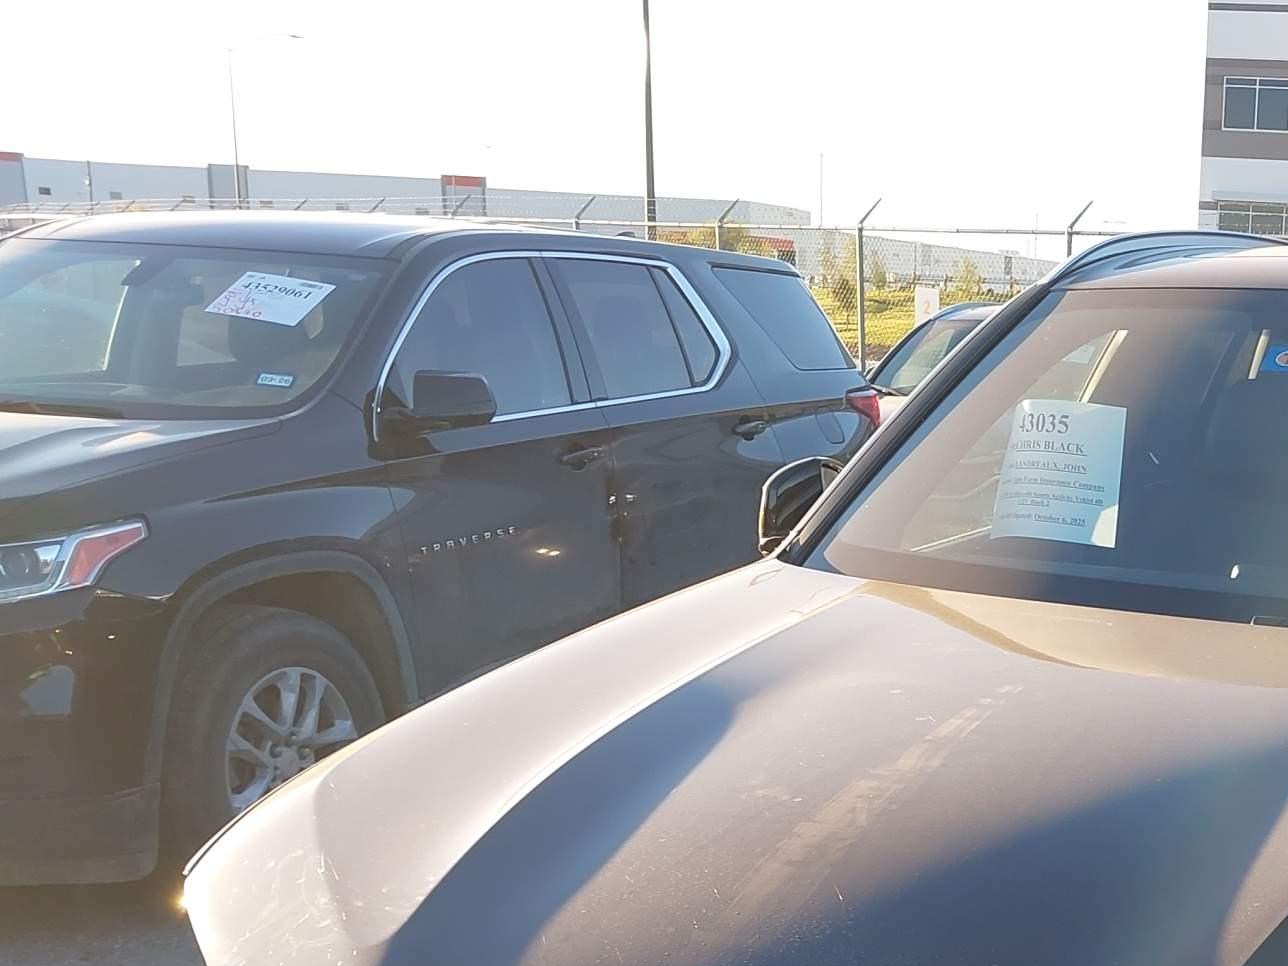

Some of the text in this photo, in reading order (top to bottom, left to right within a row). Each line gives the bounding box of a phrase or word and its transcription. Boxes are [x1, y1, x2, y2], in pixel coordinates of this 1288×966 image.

[242, 281, 313, 299] 43529061
[1044, 440, 1084, 454] BLACK
[1063, 464, 1087, 473] JOHN
[1073, 481, 1104, 491] Company
[420, 526, 516, 554] TRAVERSE
